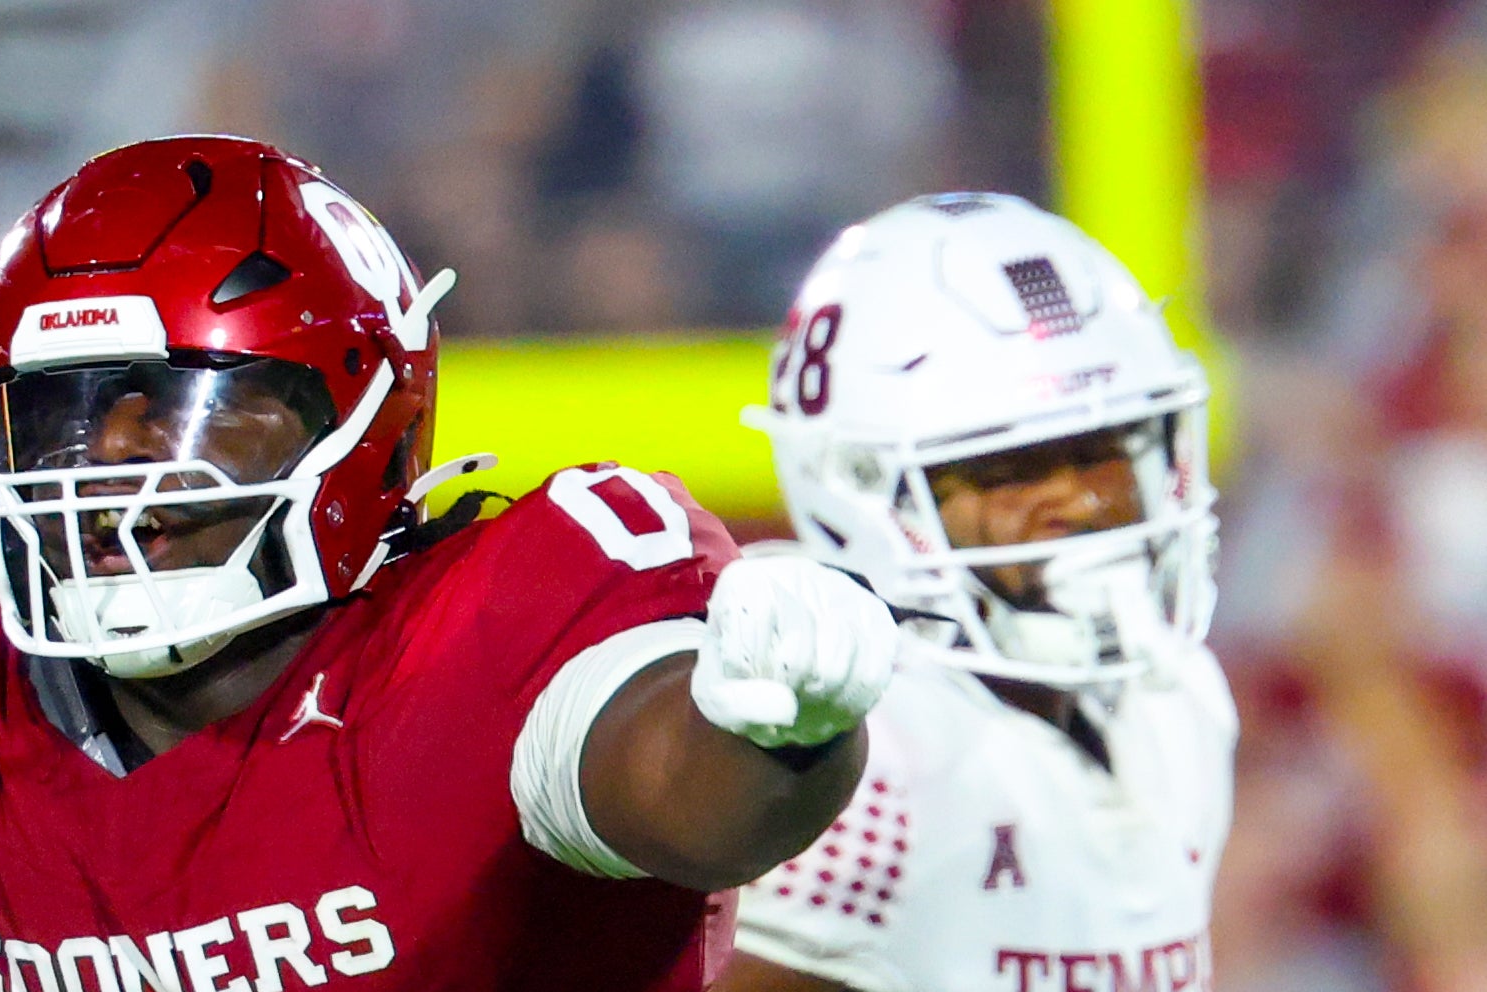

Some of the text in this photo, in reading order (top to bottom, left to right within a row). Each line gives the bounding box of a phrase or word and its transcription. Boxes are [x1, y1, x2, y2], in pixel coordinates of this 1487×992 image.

[40, 309, 119, 331] OKLAHOMA
[547, 467, 693, 571] 0
[983, 825, 1026, 890] A
